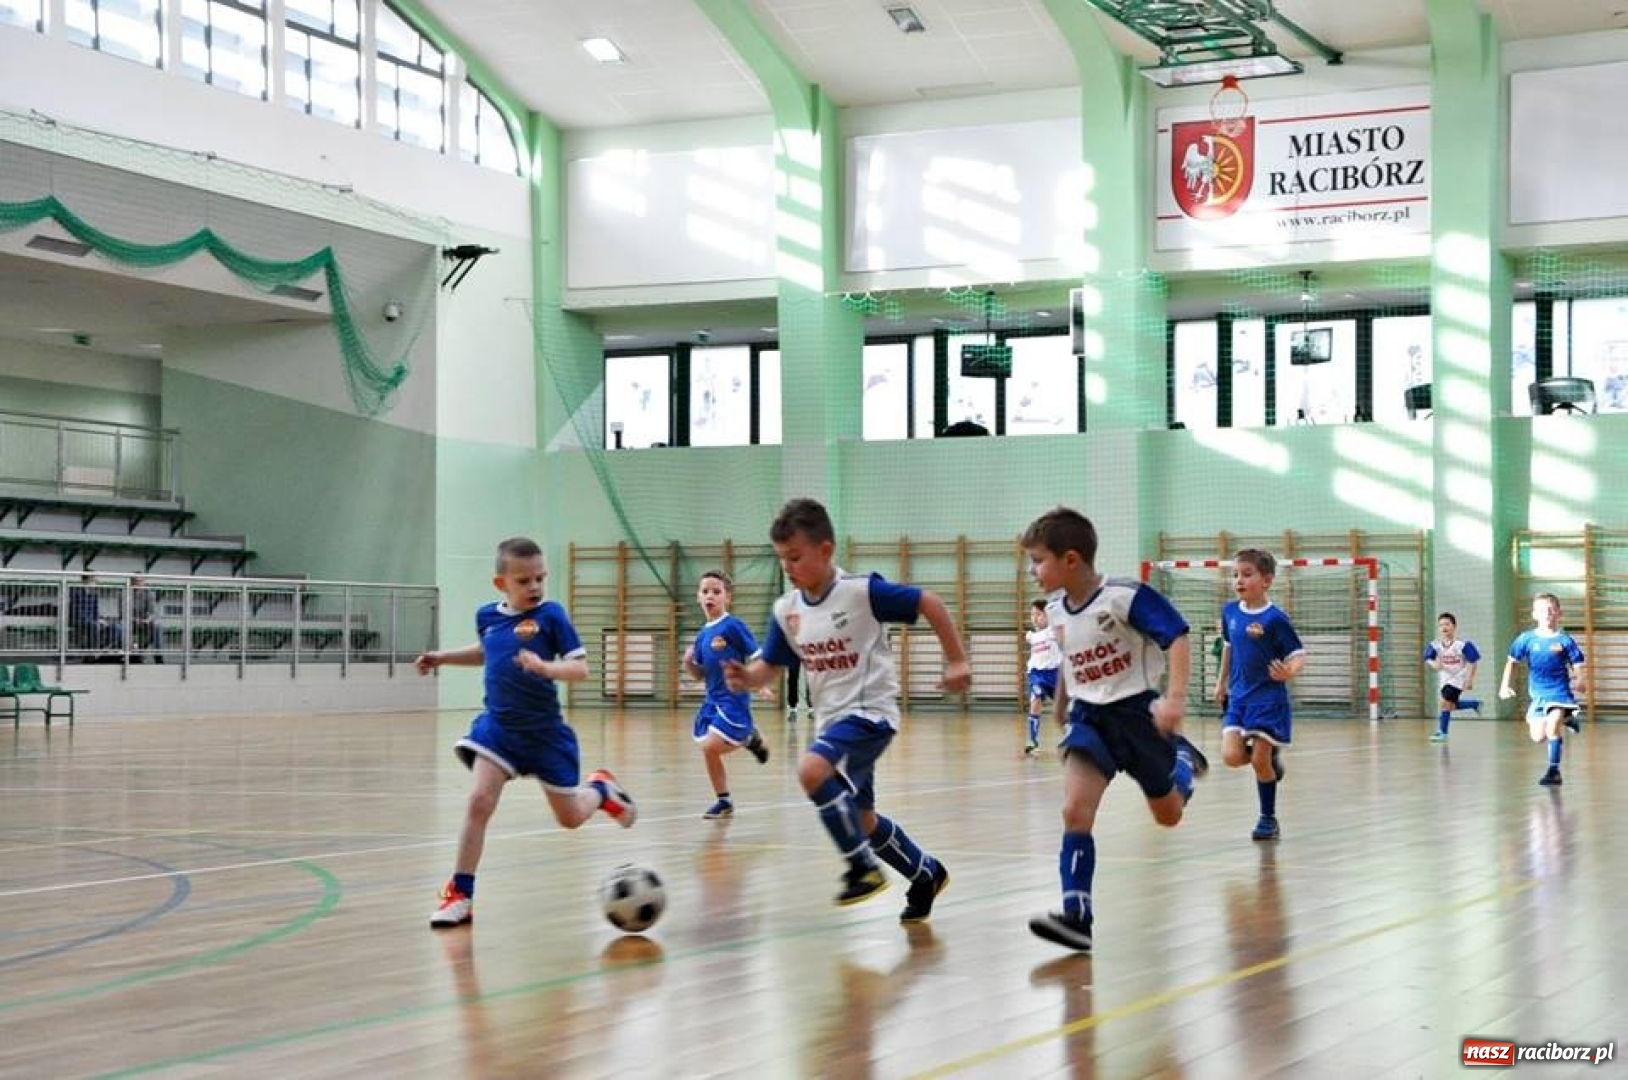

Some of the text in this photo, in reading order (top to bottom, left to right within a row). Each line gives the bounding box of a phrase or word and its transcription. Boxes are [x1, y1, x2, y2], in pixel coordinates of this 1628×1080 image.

[1288, 125, 1405, 159] MIASTO
[1268, 157, 1425, 196] RACIBÓRZ
[1276, 206, 1411, 228] www.raciborz.pl
